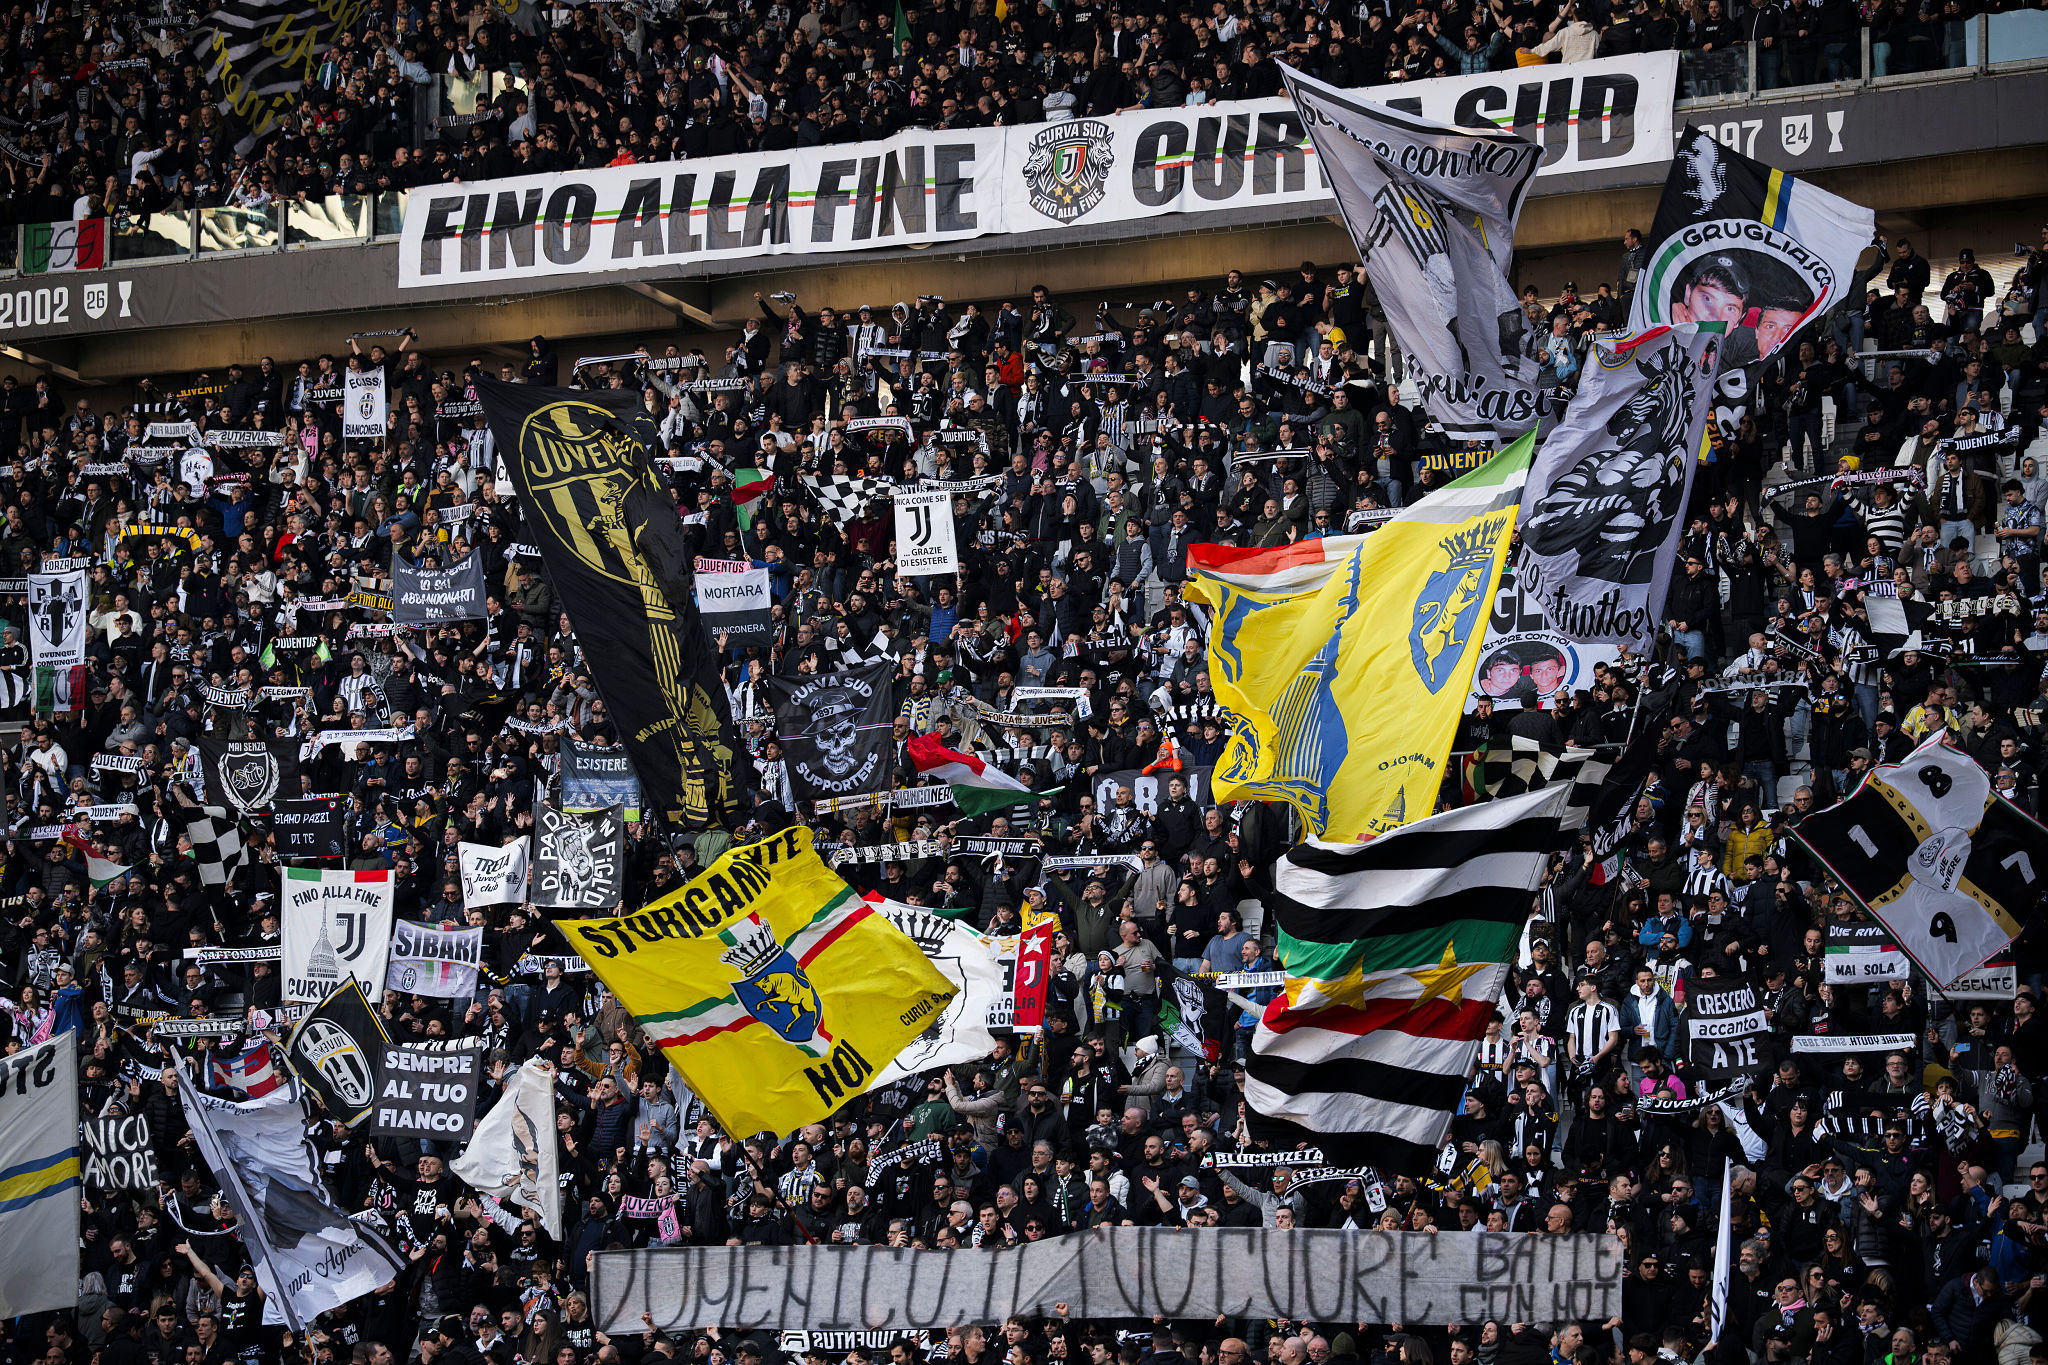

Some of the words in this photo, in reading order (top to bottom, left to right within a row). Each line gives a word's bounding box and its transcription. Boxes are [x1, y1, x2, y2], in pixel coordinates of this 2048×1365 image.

[1038, 127, 1079, 147] CURVA
[1082, 122, 1105, 138] SUD
[1784, 124, 1810, 146] 24
[421, 184, 597, 275] FINO
[611, 163, 790, 259] ALLA
[811, 143, 977, 243] FINE
[1031, 194, 1058, 216] FINO
[1058, 208, 1079, 219] ALLA
[1079, 189, 1103, 213] FINE
[1683, 221, 1831, 288] GRUGLIASCO
[0, 286, 69, 330] 2002
[86, 289, 105, 310] 26
[668, 357, 680, 369] AND
[693, 378, 744, 388] JUVENTUS
[1084, 374, 1126, 383] JUVENTUS
[313, 389, 345, 399] JUVENT
[345, 424, 383, 435] BIANCONERA
[941, 430, 976, 442] JUVENTUS
[1955, 432, 1999, 451] JUVENTUS
[1855, 468, 1904, 483] Juventus
[912, 496, 934, 505] COME
[935, 494, 947, 503] SEI
[911, 547, 943, 556] GRAZIE
[45, 560, 70, 571] FORZA
[70, 557, 91, 569] JUVE
[697, 559, 744, 573] JUVENTUS
[901, 559, 910, 567] DI
[911, 556, 948, 566] ESISTERE
[37, 588, 46, 598] P
[69, 586, 78, 598] A
[420, 579, 431, 591] LO
[434, 578, 451, 590] SAI
[704, 584, 763, 600] MORTARA
[359, 593, 377, 607] FINO
[378, 597, 394, 610] ALL
[401, 587, 475, 605] ABBANDONARTI
[1936, 599, 1995, 616] JUVENTUS
[40, 617, 50, 630] R
[64, 616, 73, 630] K
[712, 623, 766, 635] BIANCONERA
[276, 637, 317, 649] JUVENTUS
[1085, 636, 1131, 649] TREIA
[1524, 632, 1548, 643] CON
[1549, 634, 1572, 647] NOI
[36, 657, 79, 668] COMUNQUE
[39, 650, 77, 659] OVUNQUE
[790, 676, 839, 706] CURVA
[844, 677, 873, 698] SUD
[814, 706, 835, 719] 1897
[990, 712, 1014, 724] FORZA
[1032, 715, 1054, 725] JUVE
[228, 743, 242, 752] MAI
[243, 741, 267, 752] SENZA
[91, 753, 143, 772] JUVENTUS
[576, 757, 627, 772] ESISTERE
[795, 751, 879, 793] SUPPORTERS
[1918, 764, 1953, 799] 8
[1872, 776, 1925, 834] CURVA
[275, 813, 302, 825] SIAMO
[303, 812, 330, 824] PAZZI
[291, 832, 301, 845] DI
[302, 832, 314, 844] TE
[539, 811, 594, 863] PADRE
[1847, 824, 1879, 859] 1
[856, 844, 919, 859] JUVENTUS
[966, 840, 986, 853] FINO
[1007, 841, 1025, 854] FINE
[474, 852, 511, 875] TREIA
[1939, 857, 1949, 878] DUE
[1941, 854, 1962, 891] RIVIERE
[2000, 850, 2036, 885] 7
[480, 882, 499, 893] club
[1879, 883, 1906, 904] MAI
[292, 889, 320, 907] FINO
[322, 886, 352, 900] ALLA
[355, 890, 382, 908] FINE
[1972, 889, 2001, 917] SUD
[1829, 924, 1853, 938] DUE
[1929, 911, 1958, 944] 9
[395, 927, 480, 970] SIBARI
[1238, 972, 1260, 985] FINO
[1262, 970, 1285, 984] ALLA
[1836, 963, 1857, 977] MAI
[1863, 962, 1896, 975] SOLA
[1696, 982, 1757, 1016] CRESCERÒ
[899, 1000, 934, 1028] CURVA
[153, 1019, 243, 1035] Juventus
[1699, 1018, 1759, 1037] accanto
[1711, 1041, 1729, 1069] A
[1733, 1036, 1759, 1067] TE
[385, 1051, 474, 1075] SEMPRE
[803, 1037, 874, 1110] NOI
[383, 1079, 416, 1101] AL
[420, 1080, 468, 1103] TUO
[1655, 1087, 1728, 1109] JUVENTUS
[378, 1107, 464, 1134] FIANCO
[83, 1149, 160, 1190] AMORE
[869, 1154, 903, 1188] GRUPPO
[1476, 1232, 1621, 1283] BATTE
[1059, 1227, 1199, 1318] TUO
[1214, 1228, 1437, 1326] CUORE
[1459, 1282, 1535, 1322] CON
